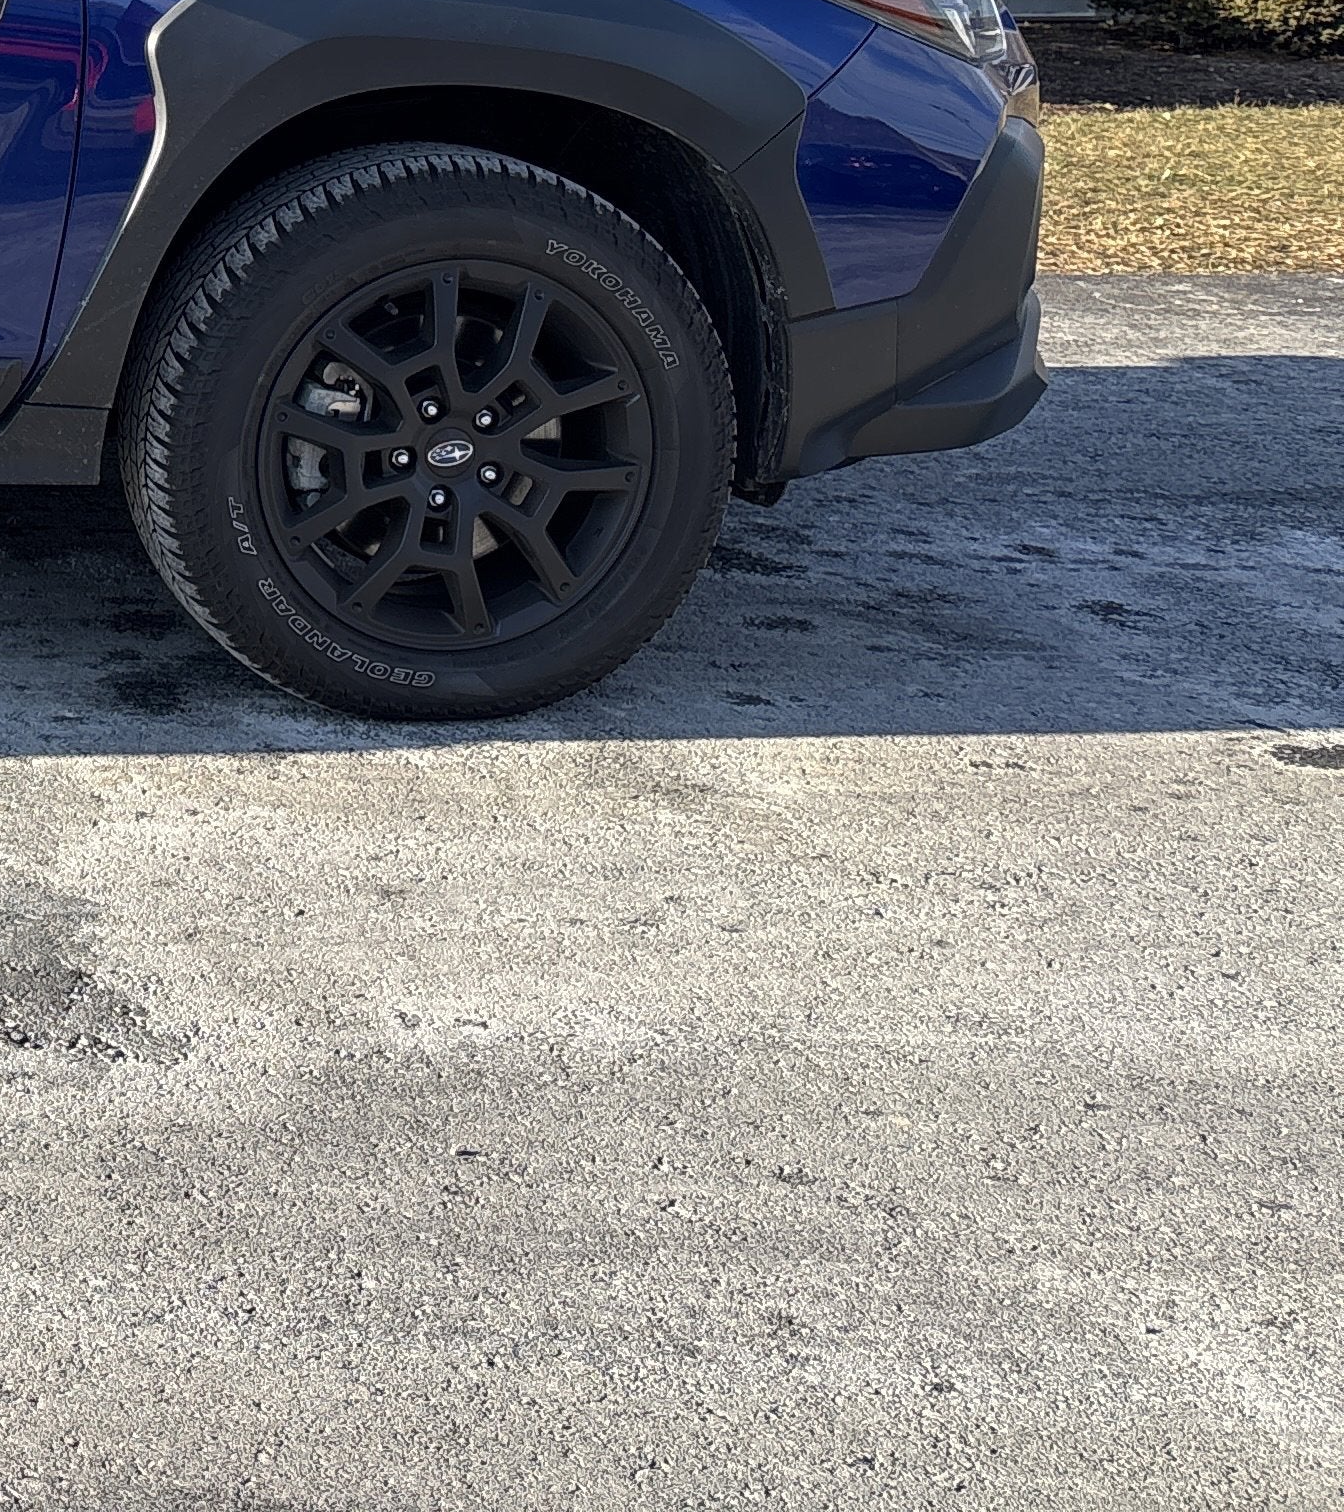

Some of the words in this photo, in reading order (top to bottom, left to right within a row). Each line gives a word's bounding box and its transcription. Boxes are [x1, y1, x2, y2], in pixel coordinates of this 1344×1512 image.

[546, 239, 680, 370] YOKOHAMA
[228, 497, 257, 555] A/T
[258, 577, 435, 687] GEOLANDAR
